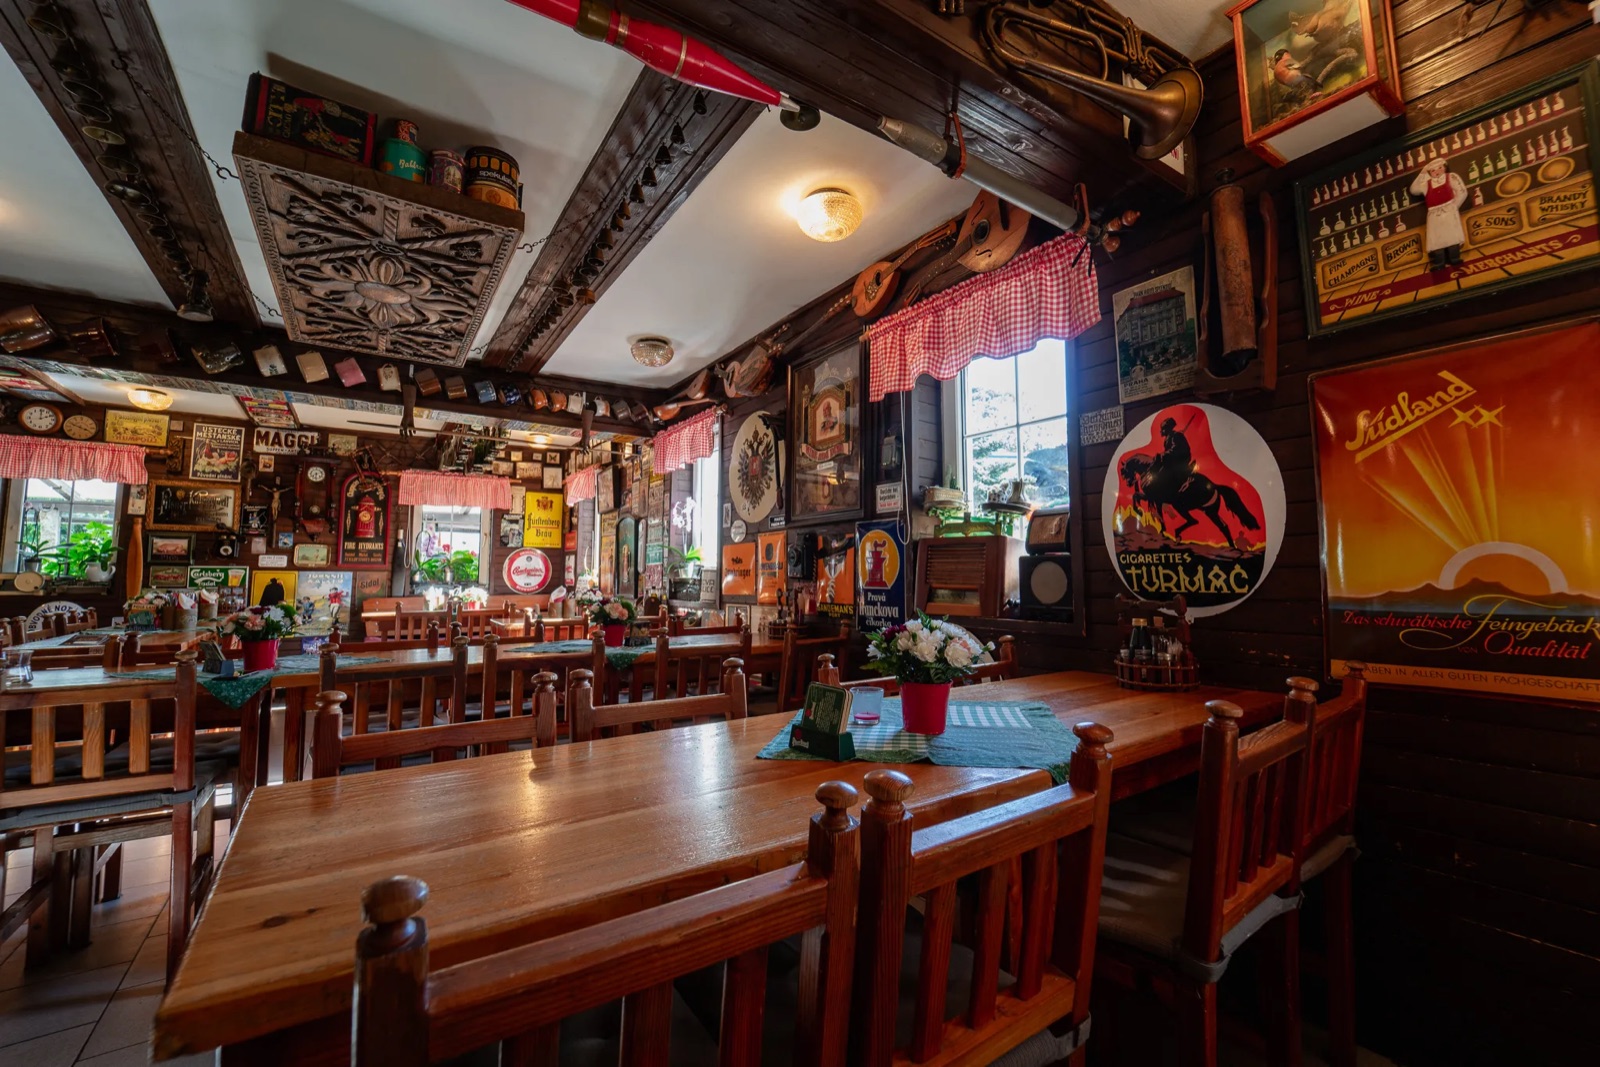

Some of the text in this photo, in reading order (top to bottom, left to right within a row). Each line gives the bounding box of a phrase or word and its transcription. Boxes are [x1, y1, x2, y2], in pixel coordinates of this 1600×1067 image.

[1539, 190, 1588, 205] BRANDY
[1539, 200, 1588, 214] WHISKY
[1472, 216, 1517, 229] & SONS
[1385, 237, 1419, 263] BROWN
[1327, 253, 1377, 287] CHAMPAGNE
[1328, 259, 1348, 275] FINE
[1344, 239, 1563, 308] WINE MERCHANTS
[1123, 376, 1150, 388] PRAHA
[344, 541, 384, 550] FIRE HYDRANTS
[1119, 551, 1193, 565] CIGARETTES
[190, 569, 225, 582] Carlsberg
[1125, 564, 1251, 595] TURMAC
[867, 592, 886, 602] Pravá
[817, 603, 855, 614] SANDEMAN'S
[1373, 610, 1472, 630] schwäbische
[1484, 630, 1593, 660] Qualität
[1364, 664, 1393, 677] ABEN
[1395, 667, 1407, 678] IN
[1411, 669, 1444, 680] ALLEN
[1447, 671, 1489, 683] GUTEN
